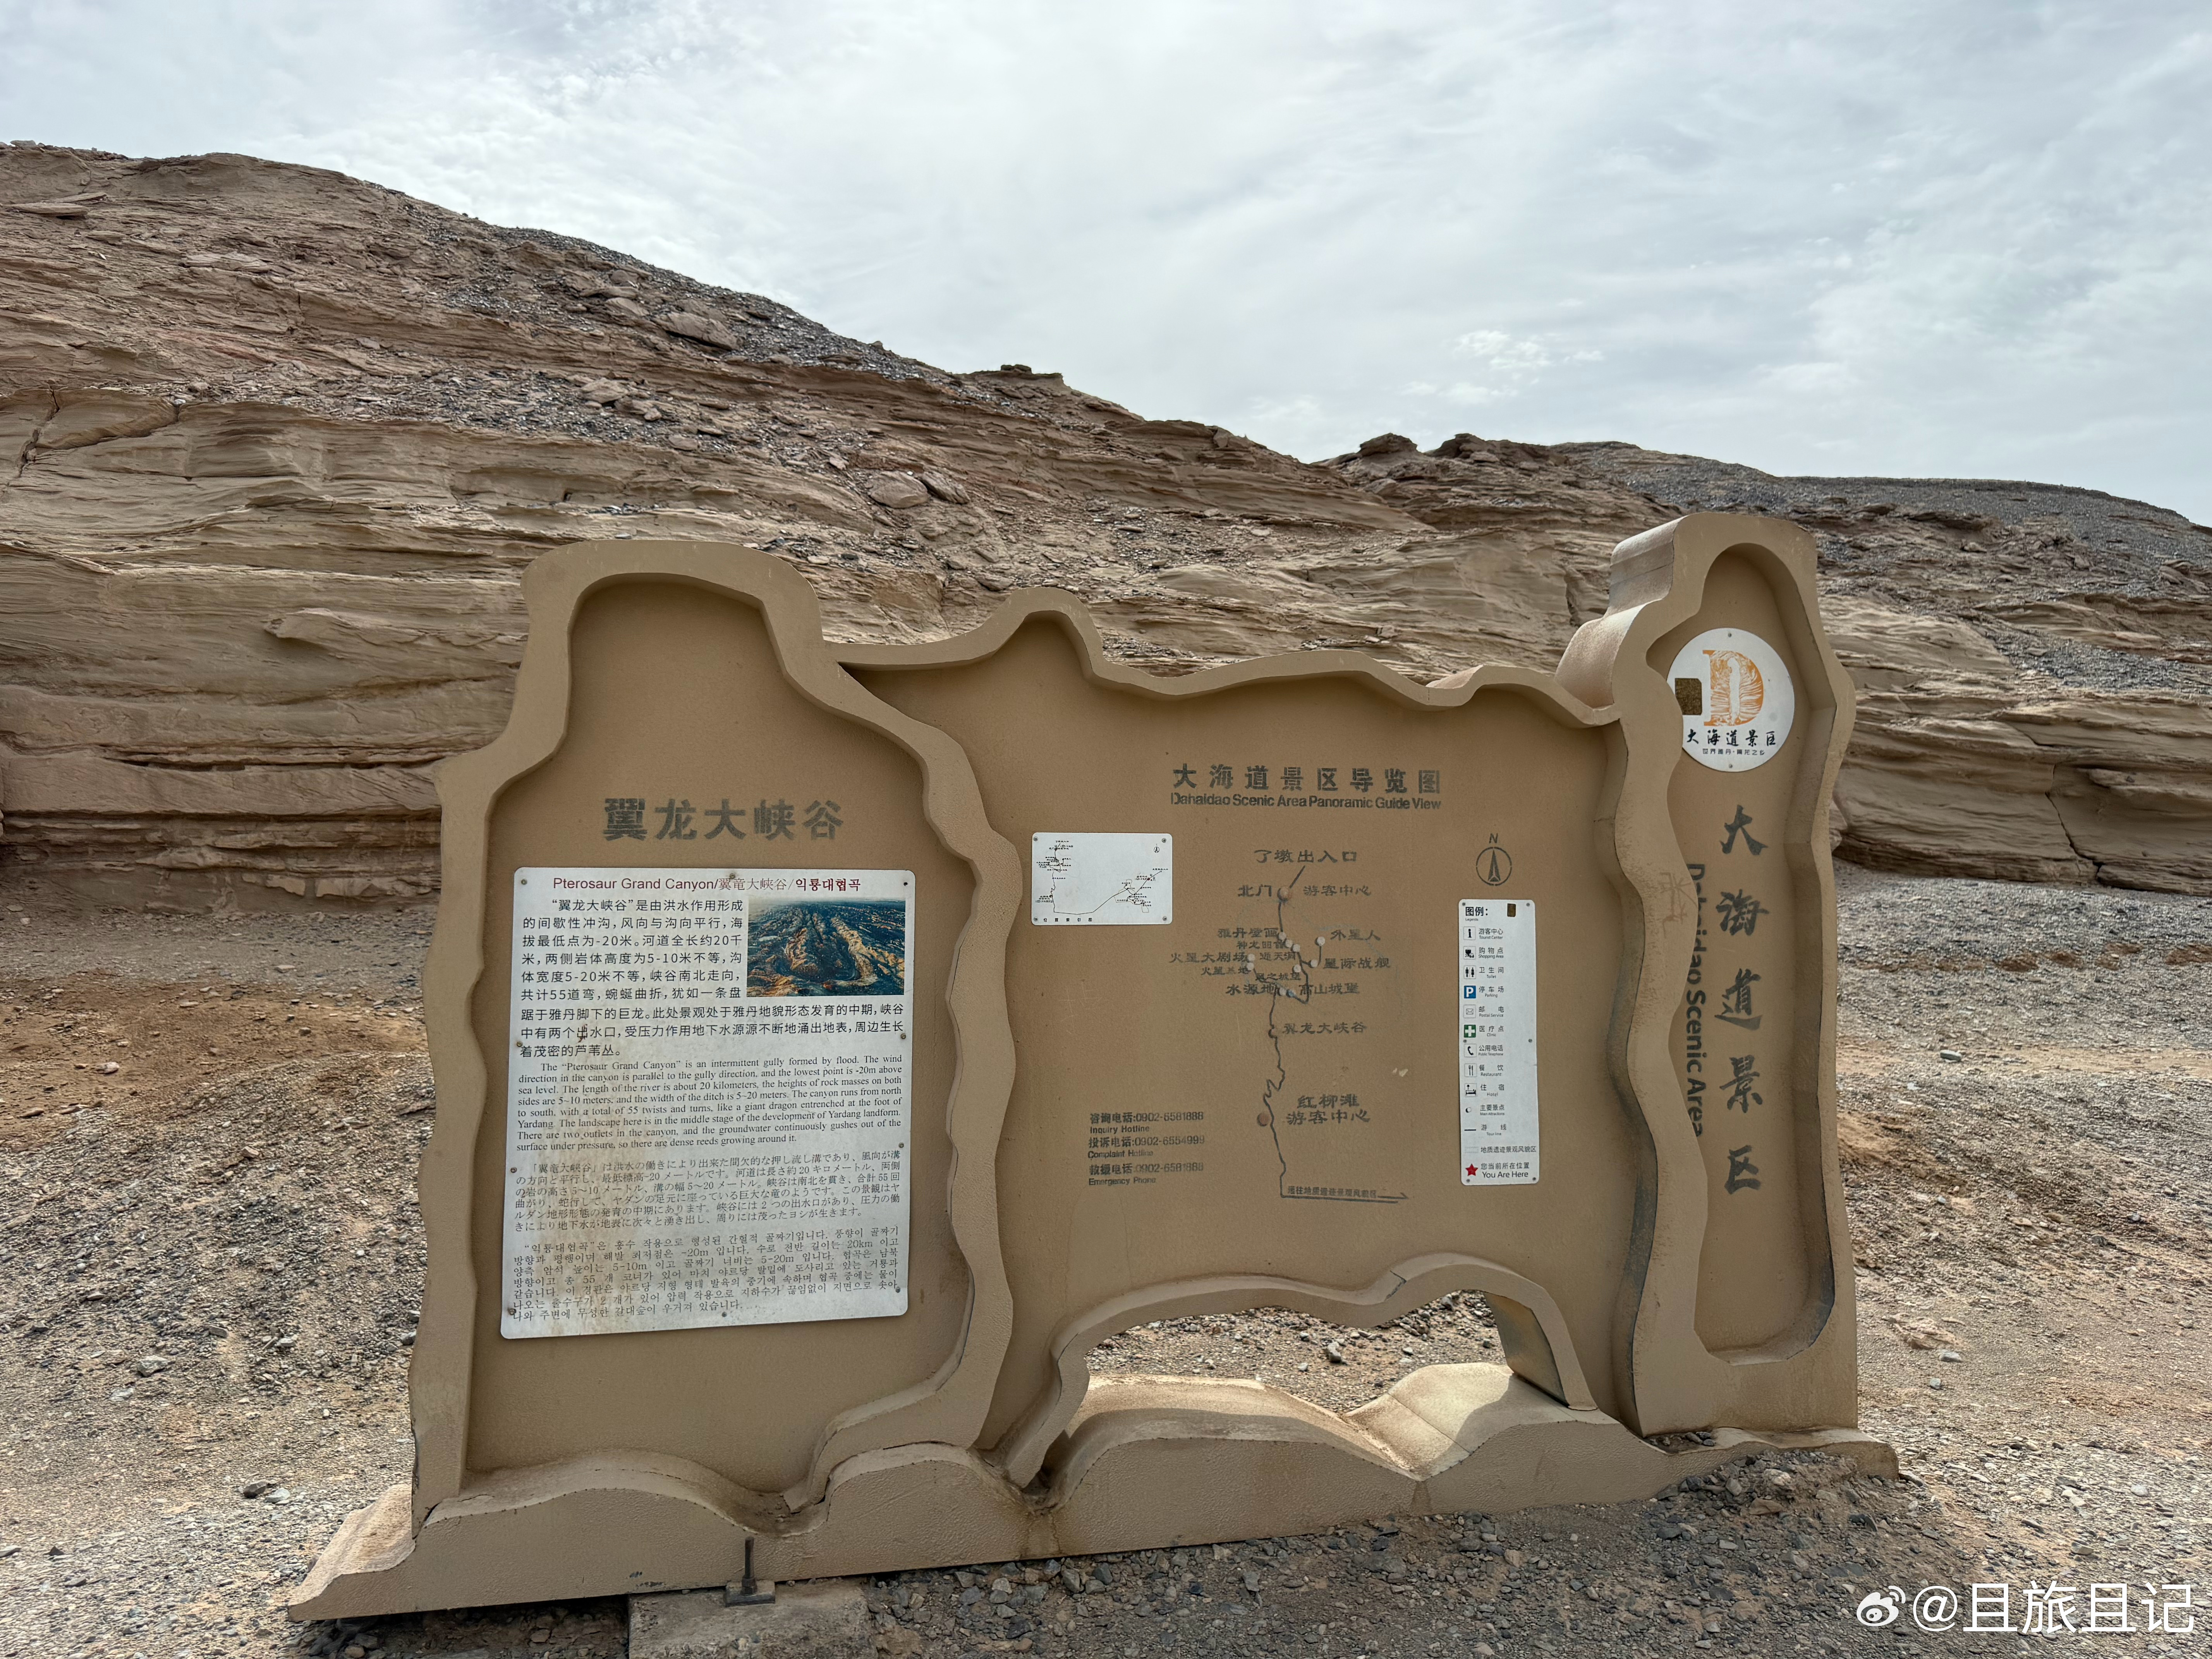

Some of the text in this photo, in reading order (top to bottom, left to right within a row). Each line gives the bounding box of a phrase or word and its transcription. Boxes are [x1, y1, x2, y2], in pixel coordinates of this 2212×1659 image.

[1686, 729, 1776, 747] 大海道景区
[1173, 763, 1440, 794] 大海道景区导览图
[1171, 792, 1441, 810] Dahaidao Scenic Area Panoramic Guide View
[603, 797, 845, 842] 翼龙大峡谷
[1489, 833, 1499, 844] N
[1254, 849, 1357, 864] 了墩出入口
[553, 878, 617, 889] Pterosaur
[621, 878, 661, 890] Grand
[1238, 884, 1272, 897] 北门
[1303, 885, 1372, 896] 游客中心
[1330, 929, 1381, 941] 外星人
[1323, 957, 1391, 969] 星际战舰
[1714, 804, 1770, 1195] 大海道景区
[1283, 1022, 1367, 1034] 翼龙大峡谷
[1686, 990, 1707, 1073] Scenic
[520, 1044, 620, 1058] 着茂密的芦苇丛。
[764, 1058, 784, 1067] gully
[789, 1057, 817, 1065] formed
[823, 1057, 832, 1066] by
[1297, 1094, 1360, 1109] 红柳滩
[1286, 1109, 1371, 1125] 游客中心
[584, 1130, 613, 1139] outlets
[719, 1125, 771, 1134] groundwater
[775, 1122, 827, 1131] continuously
[831, 1121, 857, 1130] gushes
[1090, 1125, 1118, 1134] Inquiry
[551, 1142, 575, 1150] under
[670, 1137, 694, 1146] dense
[721, 1136, 755, 1146] growing
[758, 1134, 786, 1142] around
[1088, 1149, 1125, 1159] Complaint
[1480, 1162, 1530, 1170] 您当前所在位置
[1089, 1177, 1130, 1186] Emergency
